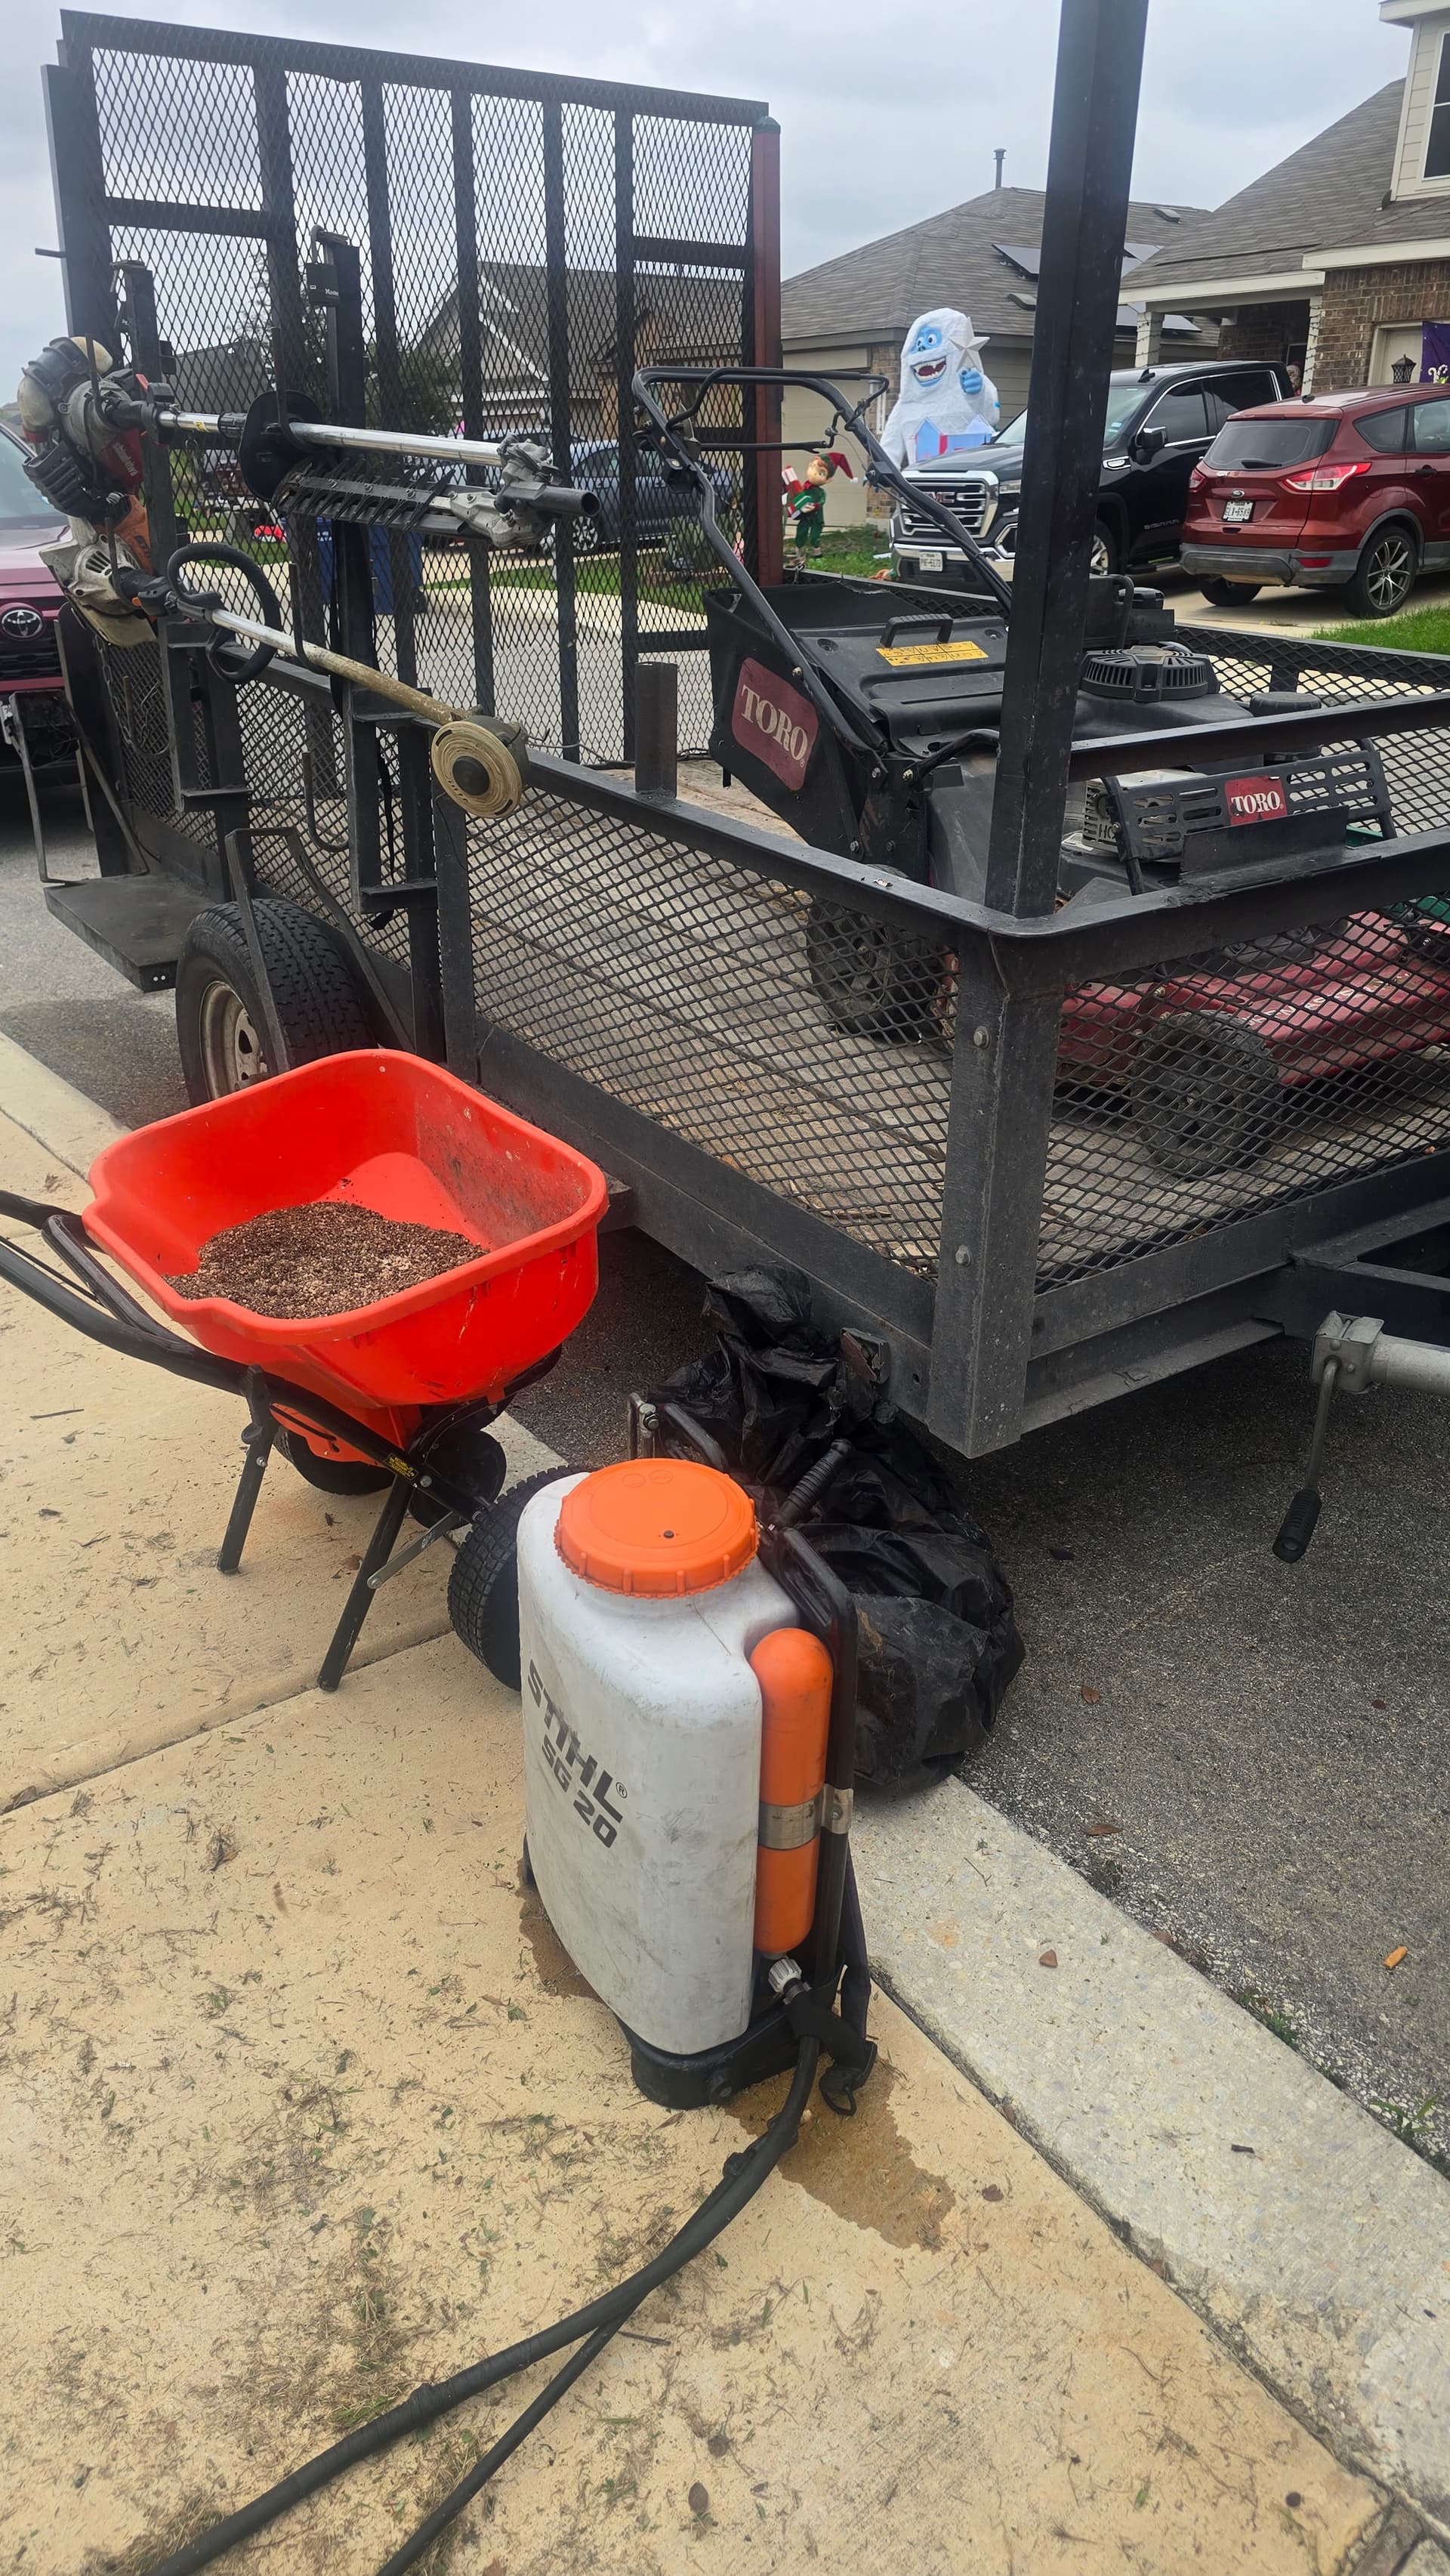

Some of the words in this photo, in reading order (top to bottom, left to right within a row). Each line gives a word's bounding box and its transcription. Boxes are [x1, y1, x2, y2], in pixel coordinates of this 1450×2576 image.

[741, 684, 808, 761] TORO
[1230, 791, 1281, 814] TORO
[528, 1658, 624, 1824] STIHL
[541, 1734, 572, 1793] SG
[573, 1790, 618, 1849] 20
